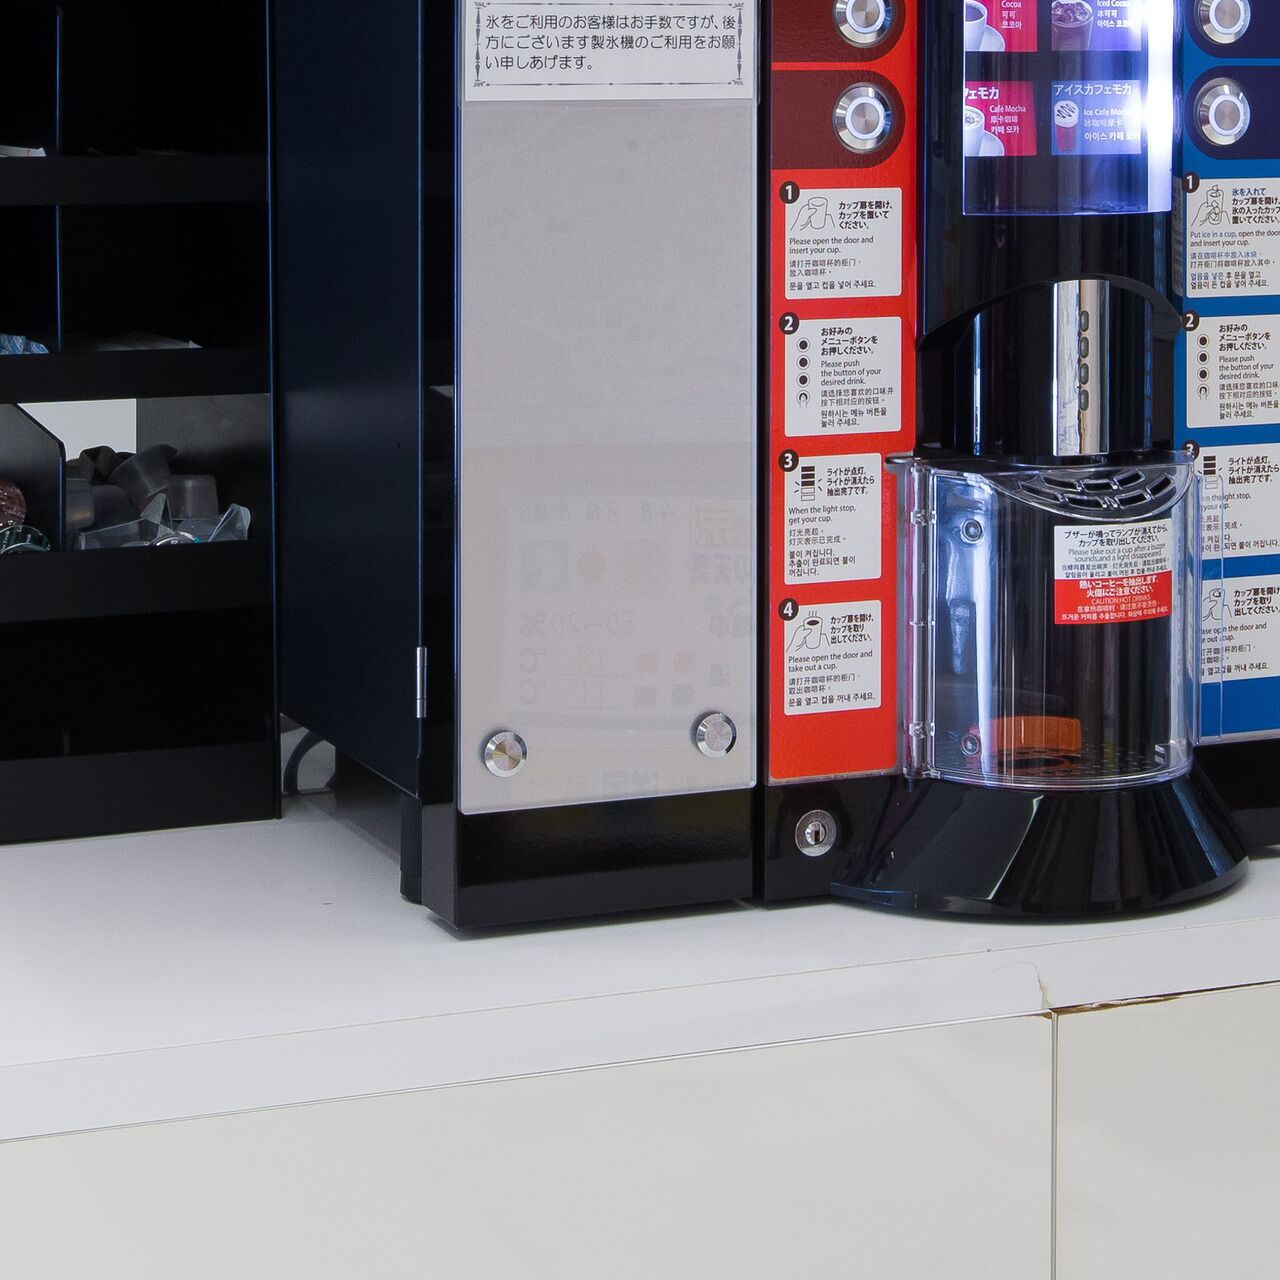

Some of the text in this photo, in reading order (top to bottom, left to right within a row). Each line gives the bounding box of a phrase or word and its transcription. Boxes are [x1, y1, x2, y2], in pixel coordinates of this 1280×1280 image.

[1002, 0, 1022, 8] Cocoa
[1097, 0, 1110, 7] Iced
[485, 13, 735, 31] 氷をご利用のお客様はお手数ですが、後
[485, 34, 735, 50] 方にございます製氷機のご利用をお願
[485, 54, 594, 71] い申しあげます。
[1054, 84, 1132, 96] アイスカフェモカ
[990, 105, 1026, 113] Café Mocha
[786, 185, 792, 200] 1
[839, 201, 892, 210] カップ扉を開け、
[839, 211, 889, 219] カップを置いて
[839, 221, 869, 229] ください。
[812, 238, 830, 247] open
[810, 247, 825, 255] your
[827, 247, 841, 255] cup.
[784, 316, 793, 331] 2
[821, 327, 853, 336] お好みの
[821, 336, 878, 346] メニューボタンを
[821, 346, 873, 356] お押しください。
[821, 360, 860, 369] Please push
[821, 377, 865, 386] desired drink.
[784, 453, 793, 468] 3
[827, 476, 874, 486] ライトが消えたら
[827, 486, 868, 496] 抽出完了です。
[784, 602, 793, 616] 4
[831, 624, 864, 634] カップを取り
[831, 634, 872, 644] 出してください。
